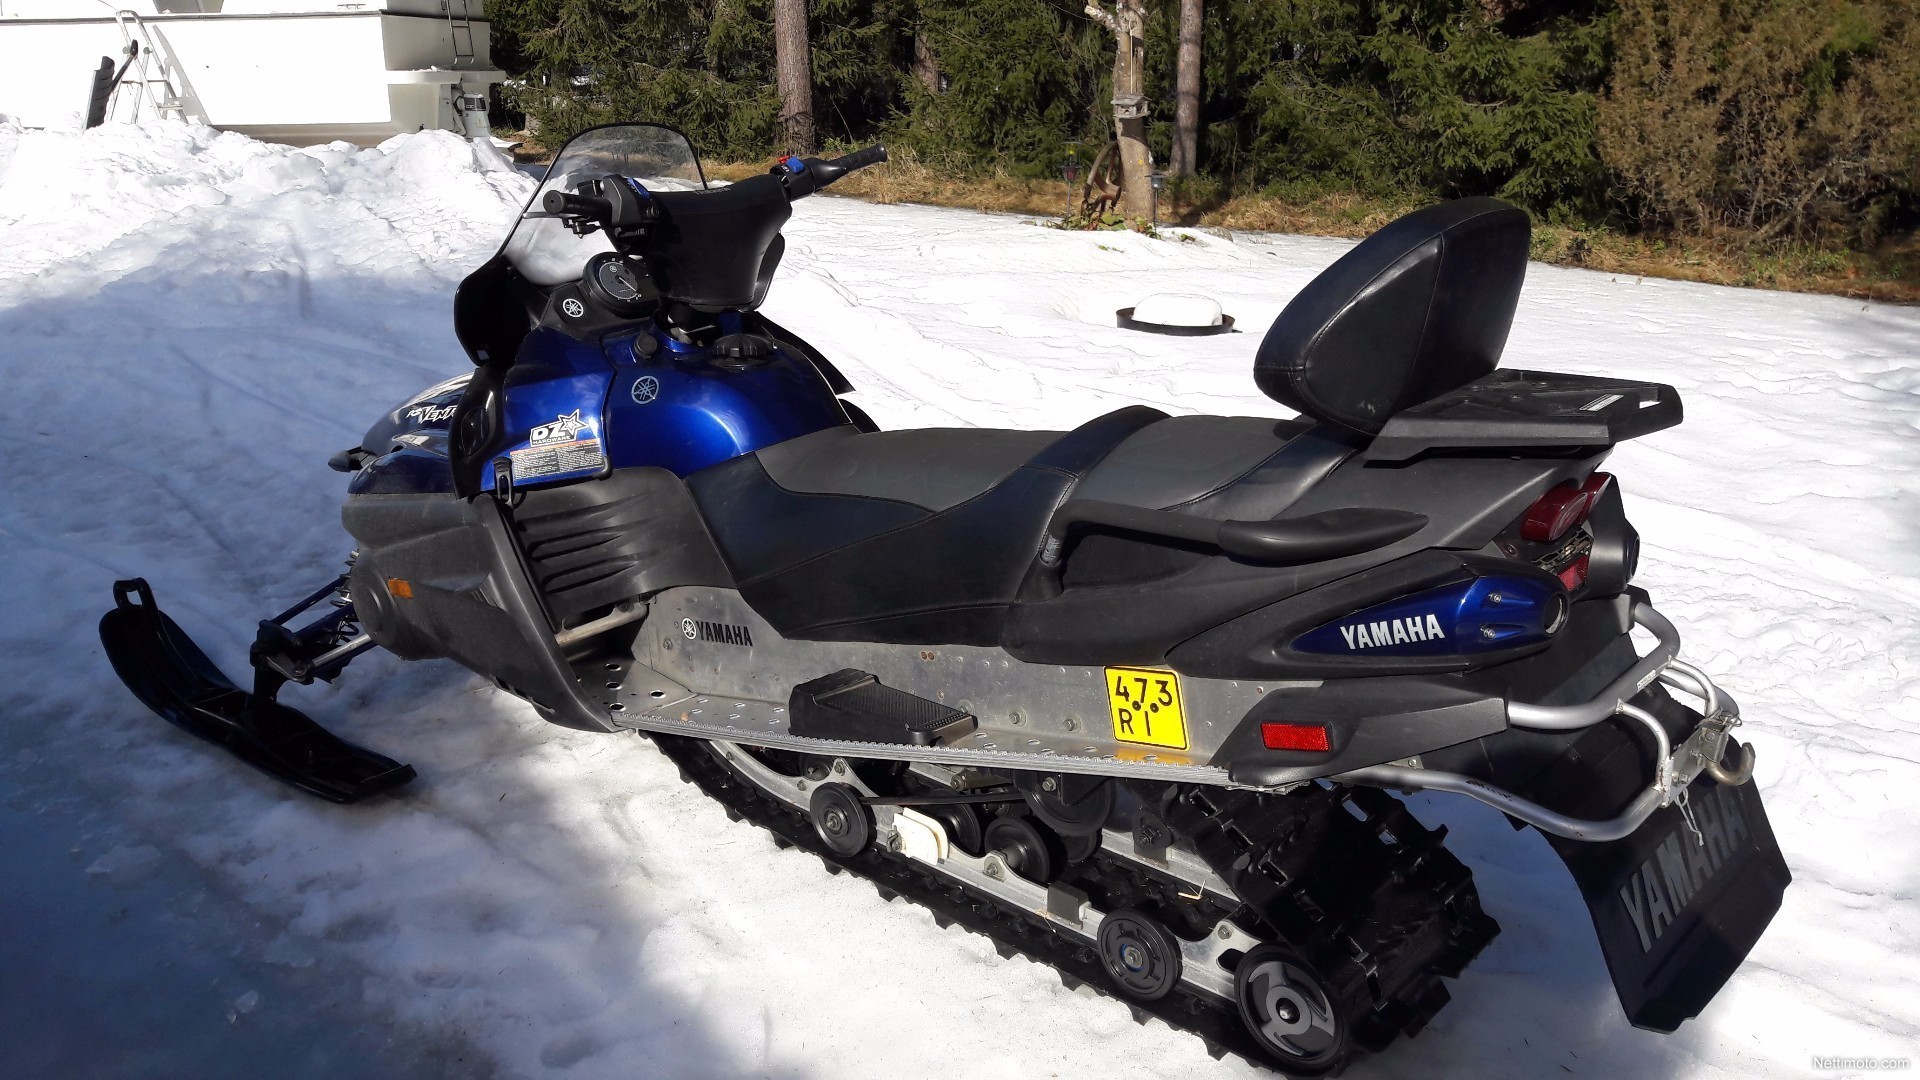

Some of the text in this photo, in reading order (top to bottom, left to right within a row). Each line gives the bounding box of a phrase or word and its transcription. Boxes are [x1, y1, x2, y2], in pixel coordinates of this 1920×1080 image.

[532, 422, 565, 440] DZ
[696, 621, 753, 647] YAMAHA
[1340, 614, 1445, 650] YAMAHA
[1115, 676, 1173, 707] 473
[1619, 784, 1748, 953] YAMAHA
